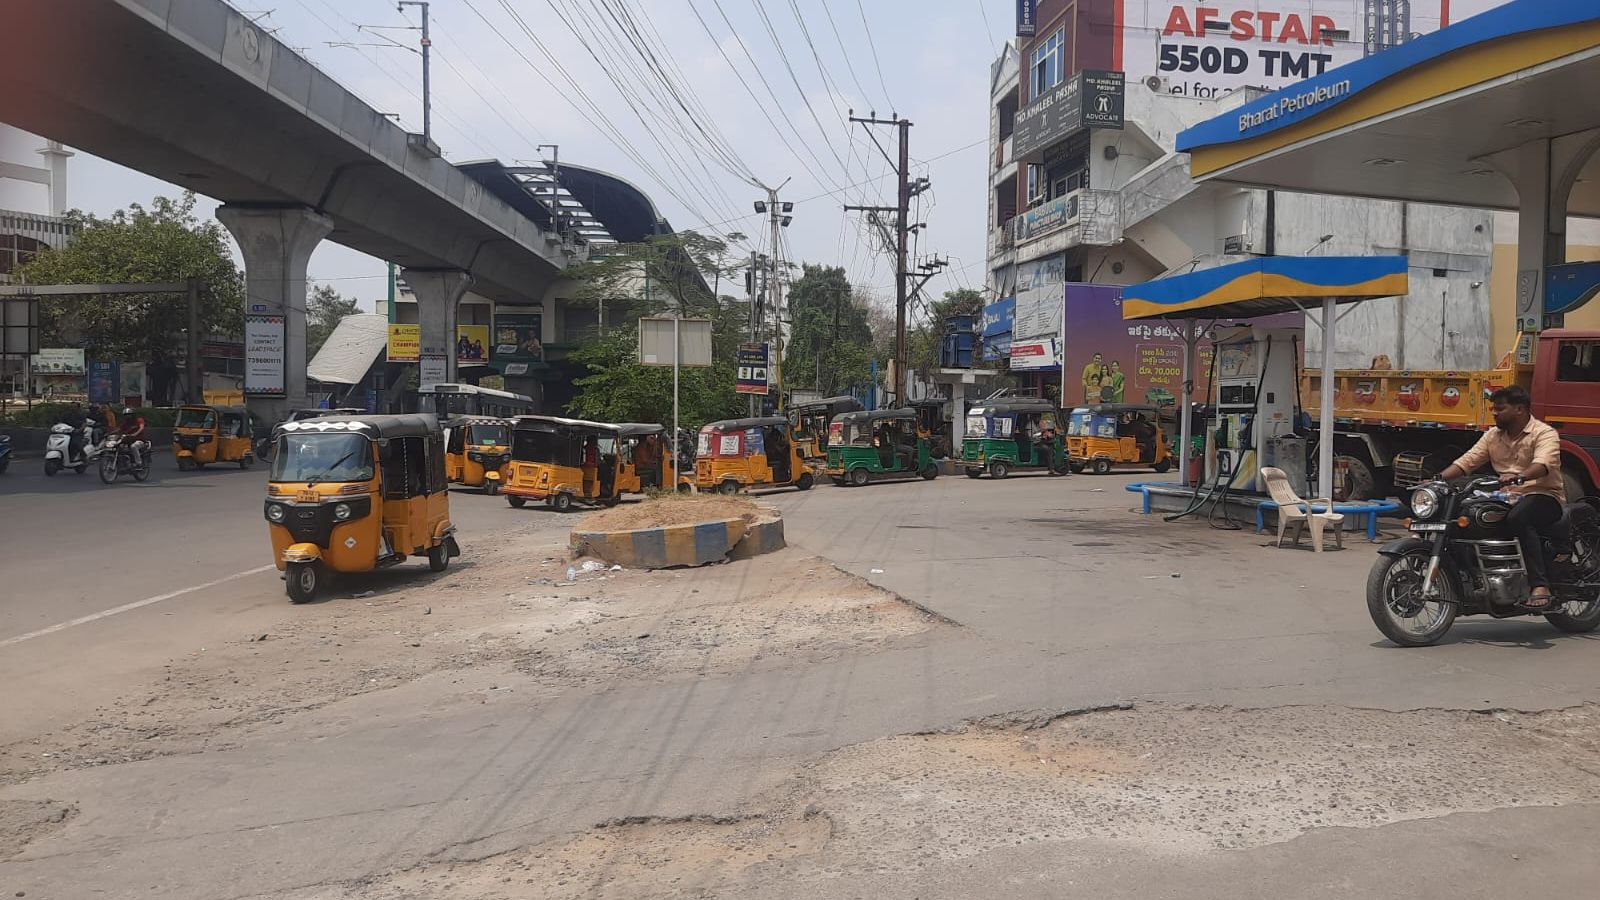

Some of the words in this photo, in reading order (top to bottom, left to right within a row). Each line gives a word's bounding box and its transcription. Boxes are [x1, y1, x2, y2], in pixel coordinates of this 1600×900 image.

[1162, 5, 1219, 38] AF
[1230, 10, 1336, 47] STAR
[1159, 44, 1249, 75] 550D
[1258, 50, 1333, 79] TMT
[1055, 79, 1078, 102] PASHA
[1193, 82, 1218, 98] for
[1086, 113, 1119, 121] ADVOCATE
[1239, 102, 1279, 132] Bharat
[1280, 79, 1350, 115] Petroleum
[1154, 367, 1181, 377] 70,000
